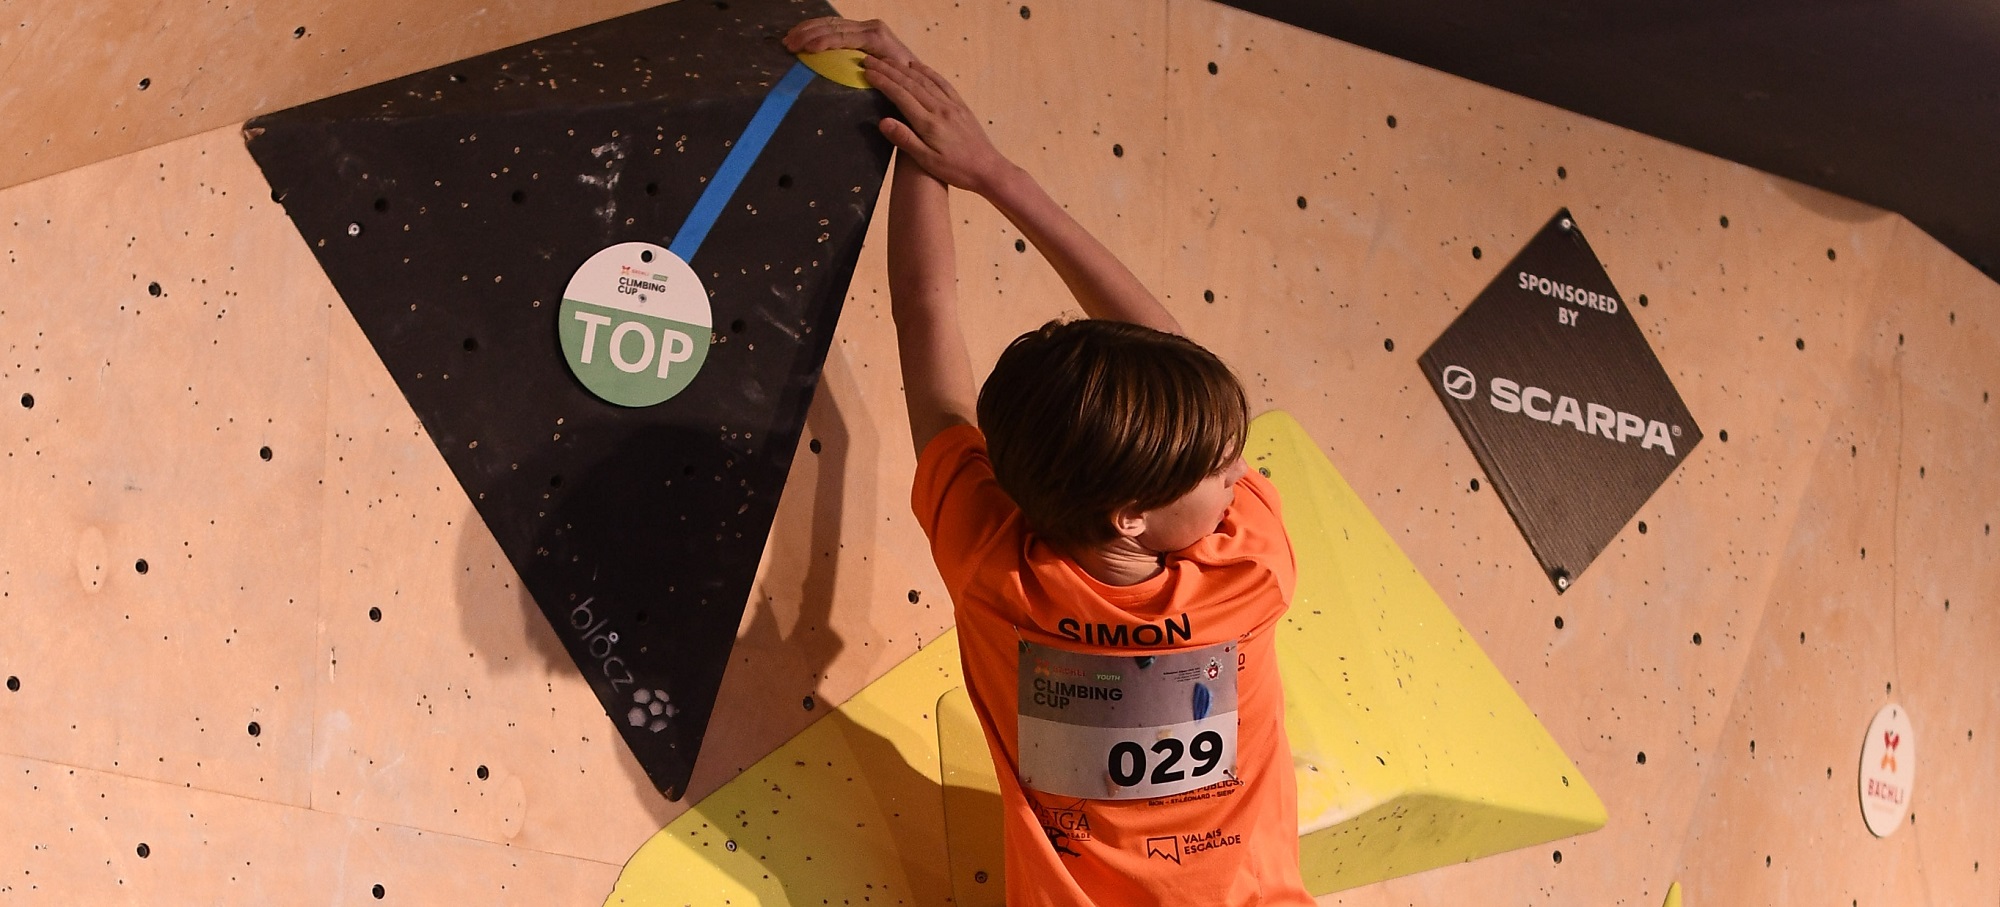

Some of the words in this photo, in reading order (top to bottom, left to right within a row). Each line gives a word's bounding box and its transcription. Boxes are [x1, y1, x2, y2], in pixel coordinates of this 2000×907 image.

[617, 285, 638, 295] CUP
[618, 276, 666, 293] CLIMBING
[1518, 271, 1618, 315] SPONSORED
[1558, 306, 1579, 327] BY
[574, 310, 694, 379] TOP
[1057, 612, 1192, 647] SIMON
[1096, 673, 1121, 681] YOUTH
[1033, 678, 1123, 701] CLIMBING
[1033, 692, 1070, 709] CUP
[1108, 730, 1223, 787] 029
[1182, 828, 1222, 845] VALAIS
[1183, 835, 1241, 855] ESCALADE
